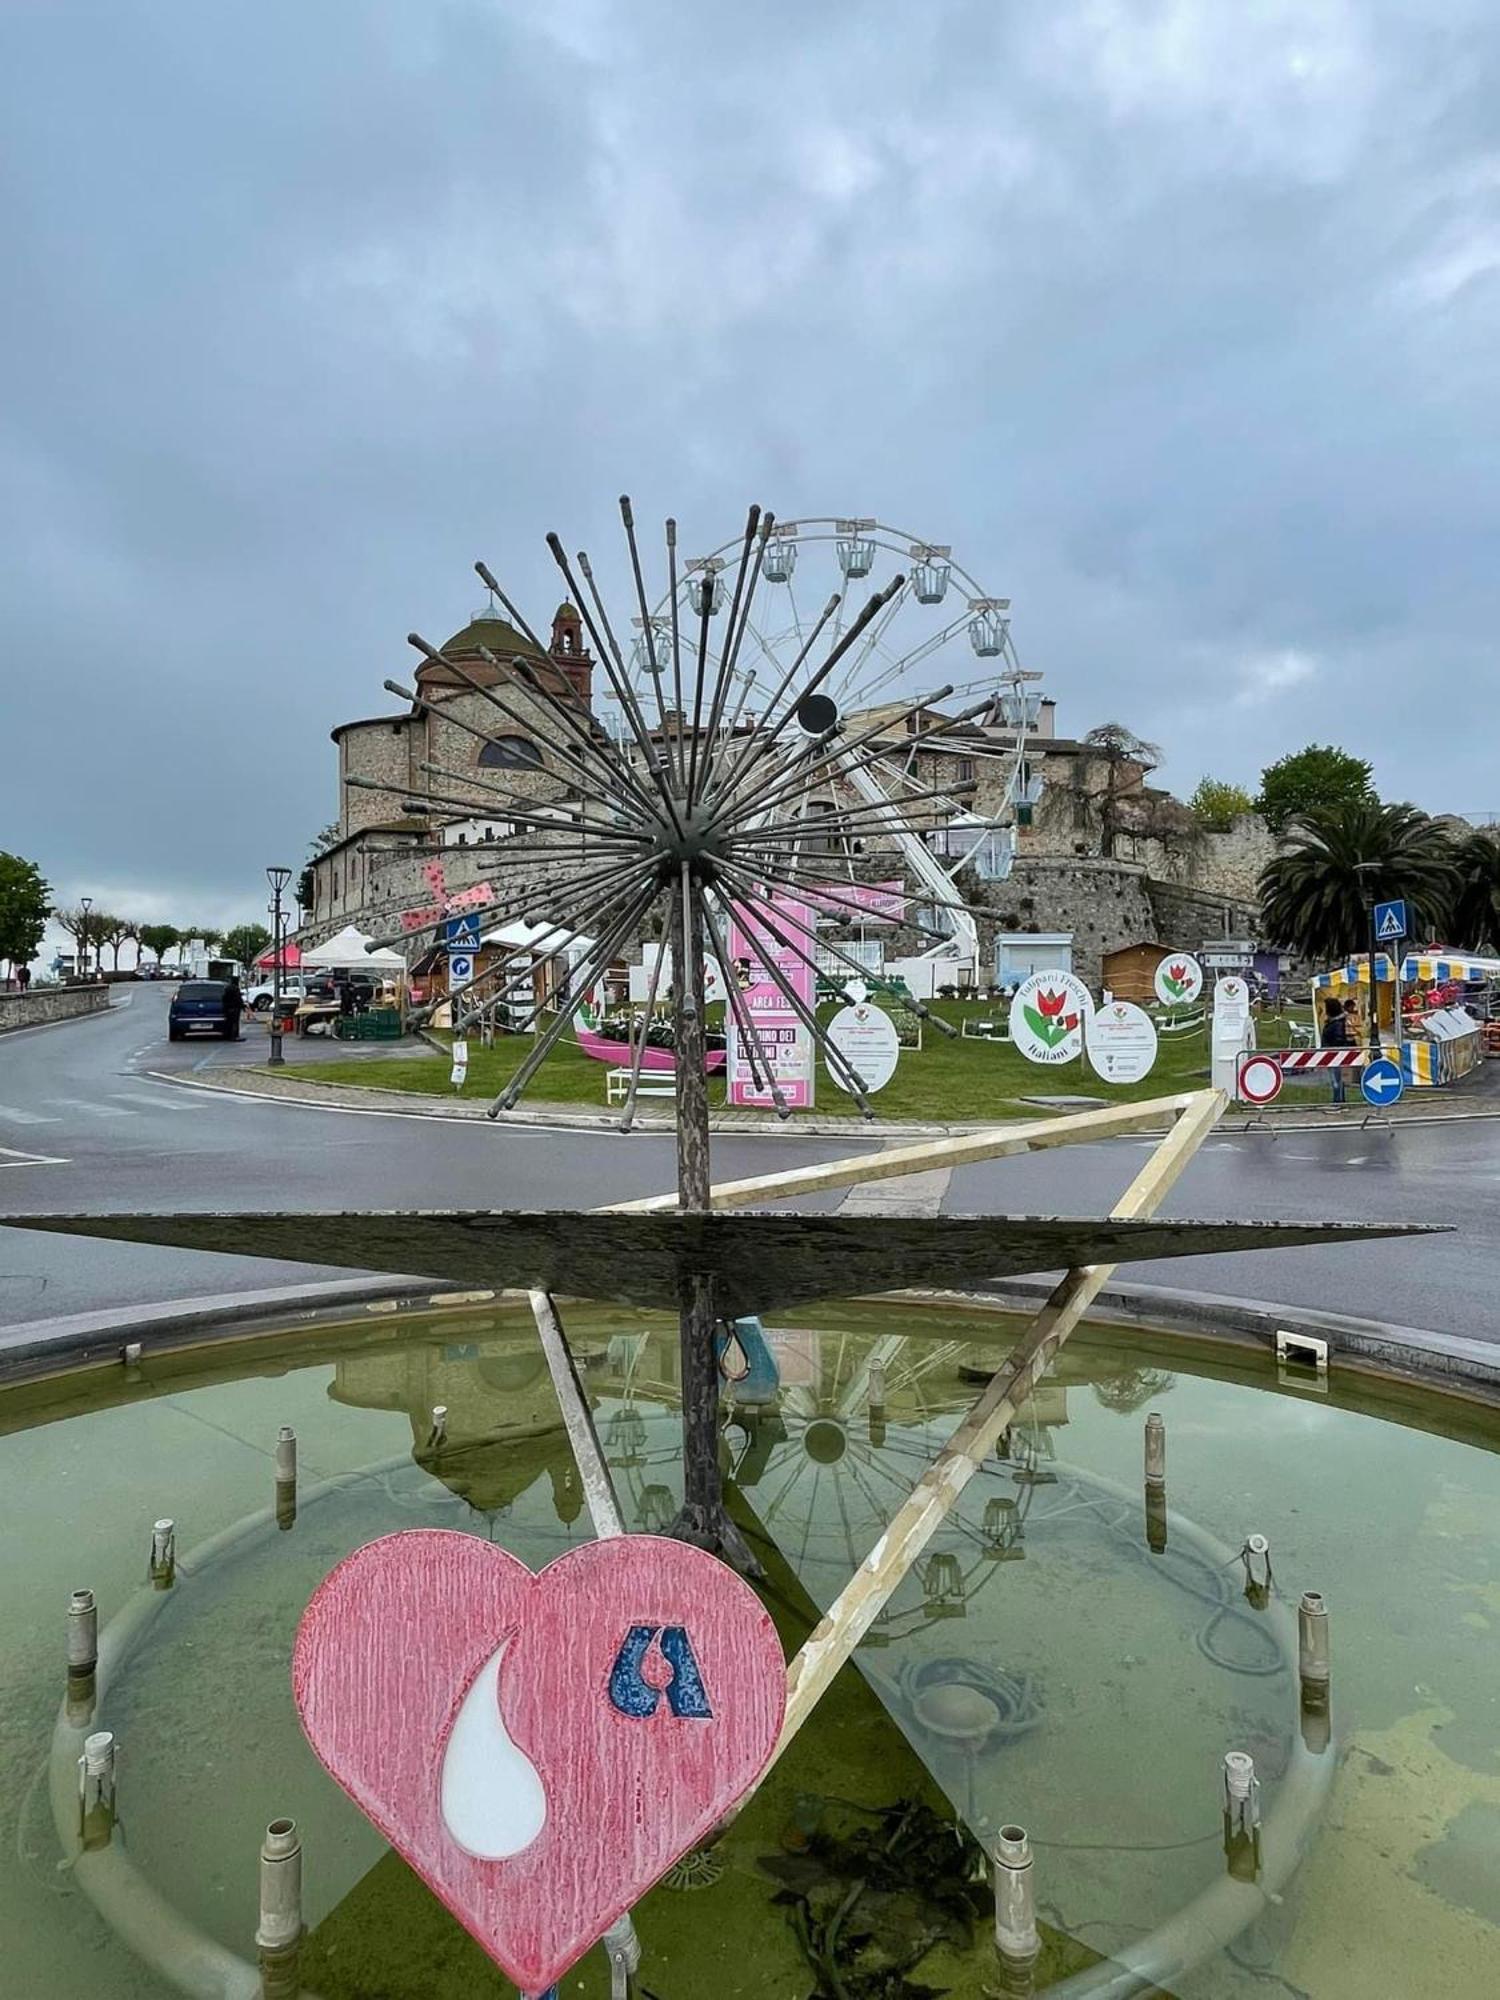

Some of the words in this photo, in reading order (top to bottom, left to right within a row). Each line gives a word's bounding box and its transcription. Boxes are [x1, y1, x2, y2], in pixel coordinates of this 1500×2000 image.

[1019, 973, 1058, 997] Tulipani
[738, 1030, 776, 1042] ADINO
[1028, 1043, 1069, 1061] Italiani
